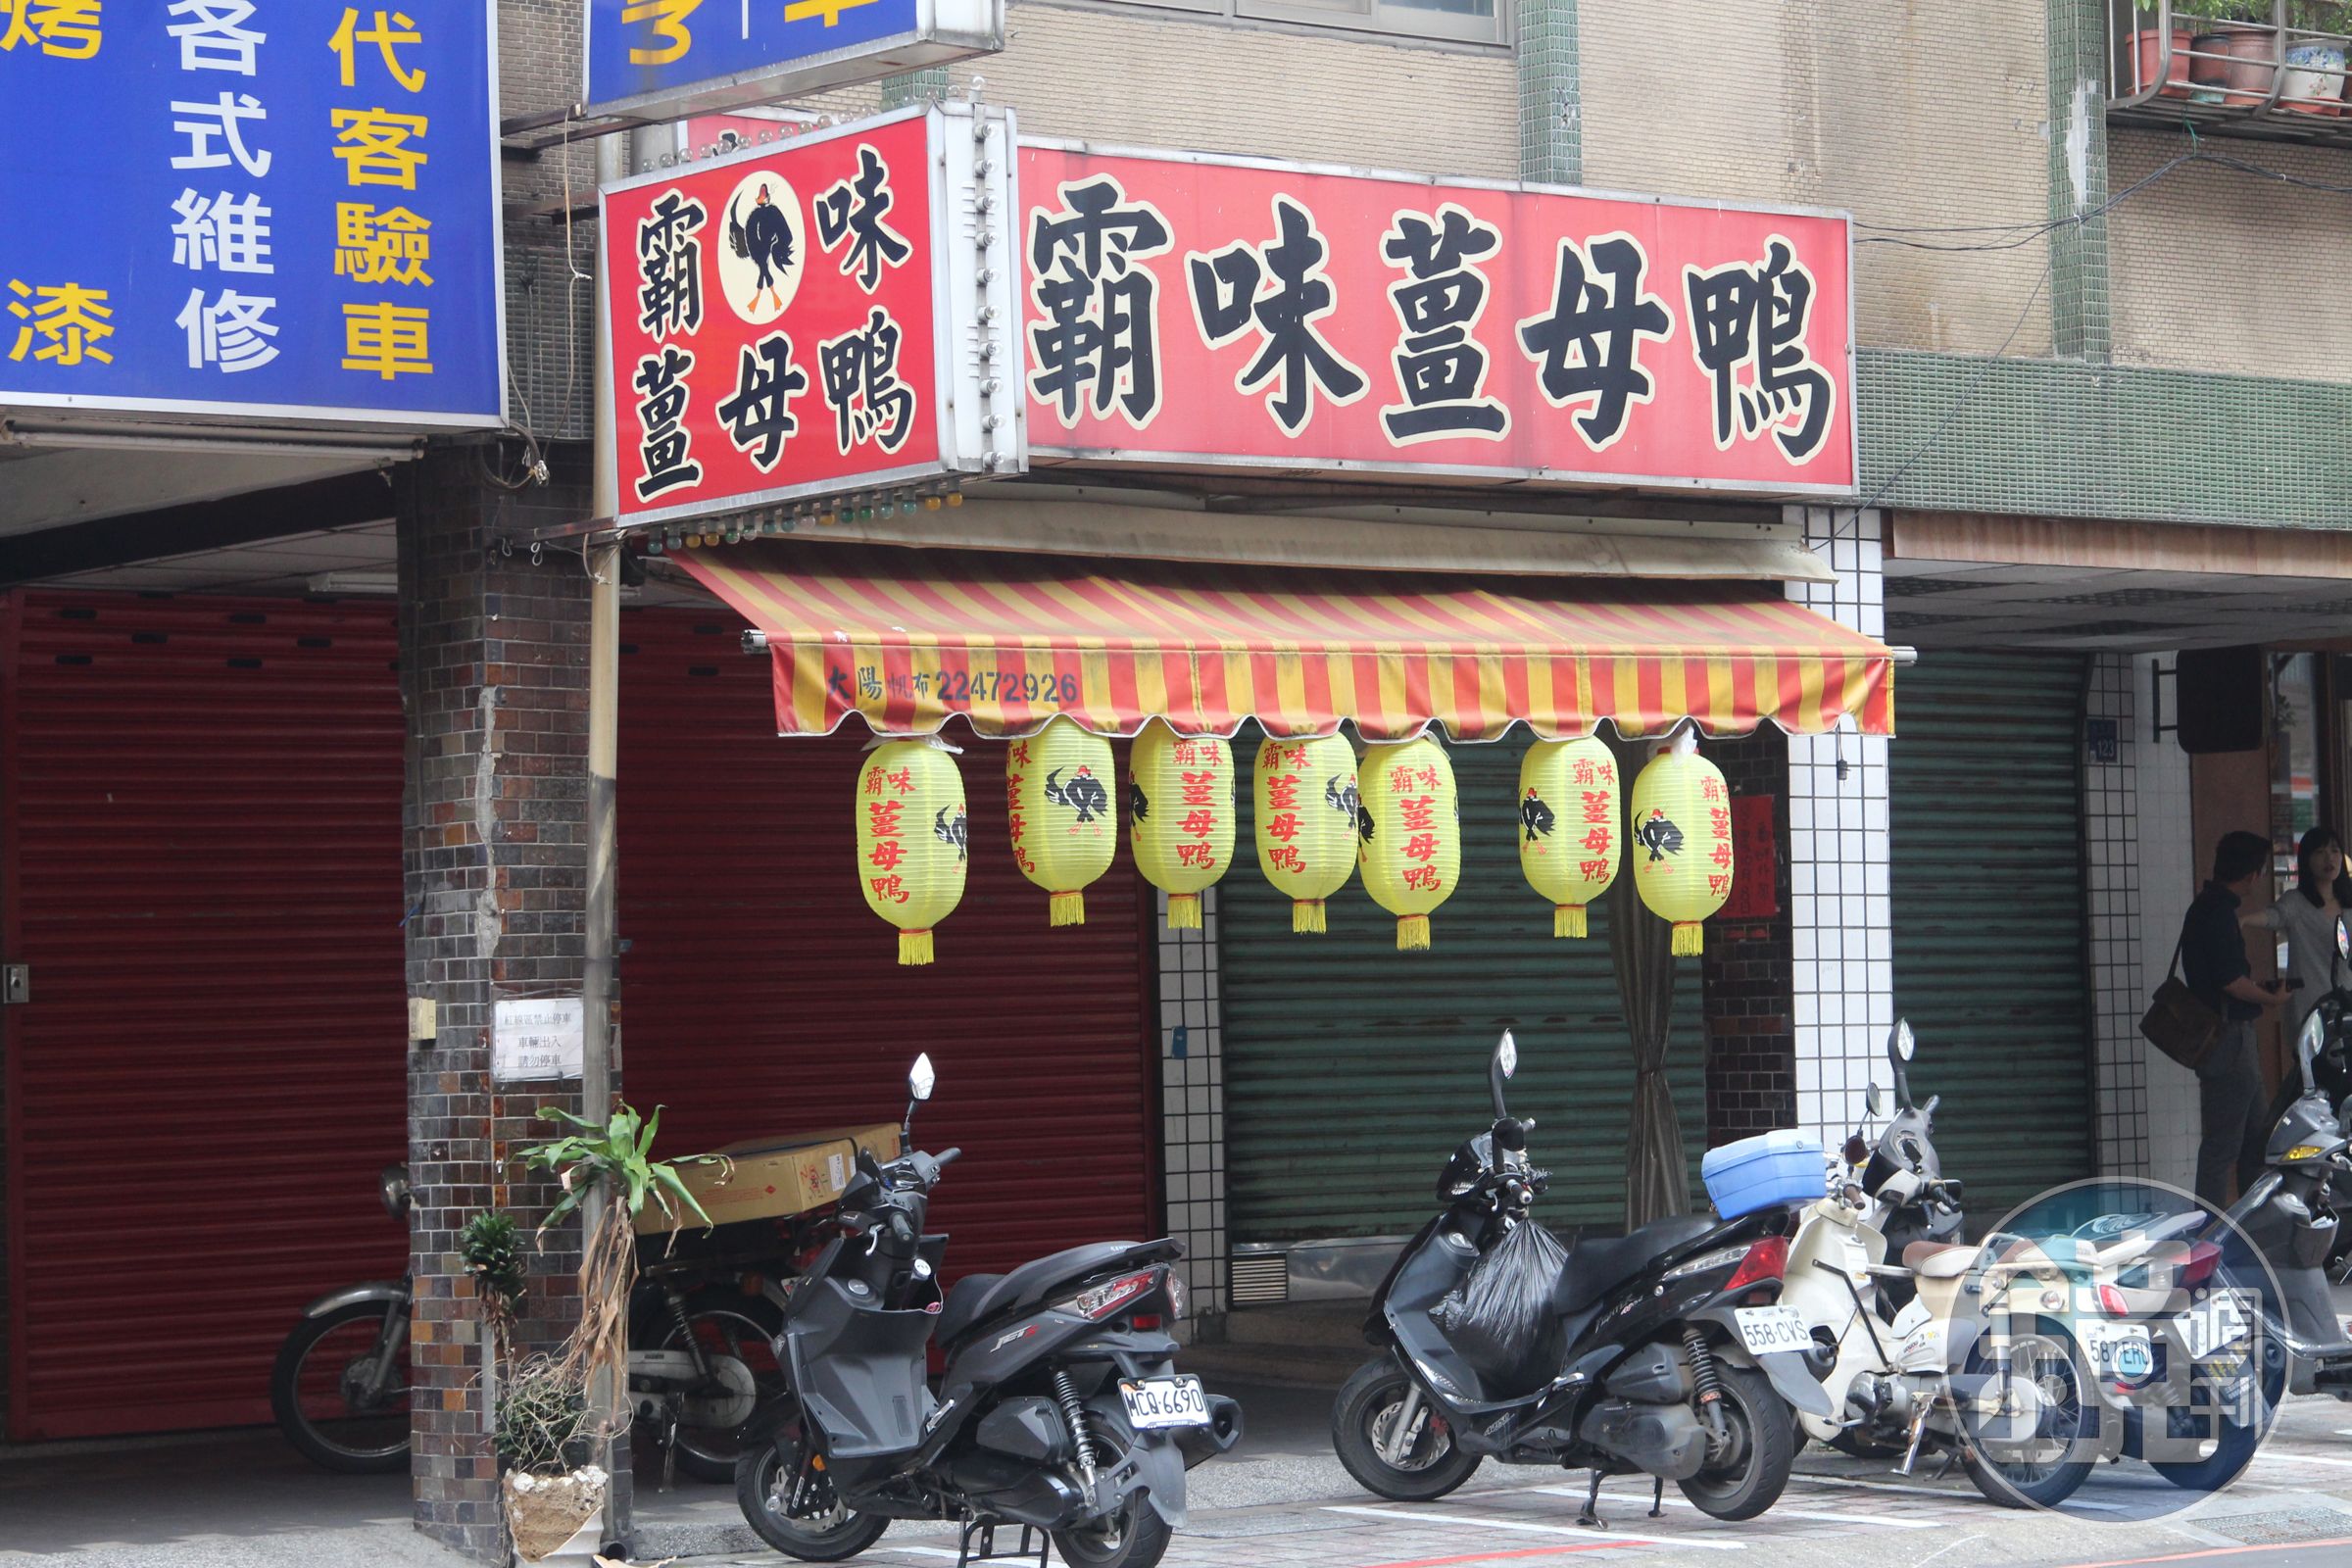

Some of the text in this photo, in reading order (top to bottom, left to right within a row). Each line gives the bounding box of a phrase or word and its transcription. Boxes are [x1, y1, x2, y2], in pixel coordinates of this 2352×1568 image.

[167, 0, 280, 373] 各式維修
[328, 7, 434, 380] 代客驗車
[1032, 180, 1830, 459] 霸味薑母鴨
[936, 671, 1078, 703] 22472926
[517, 1054, 563, 1067] 請勿停車
